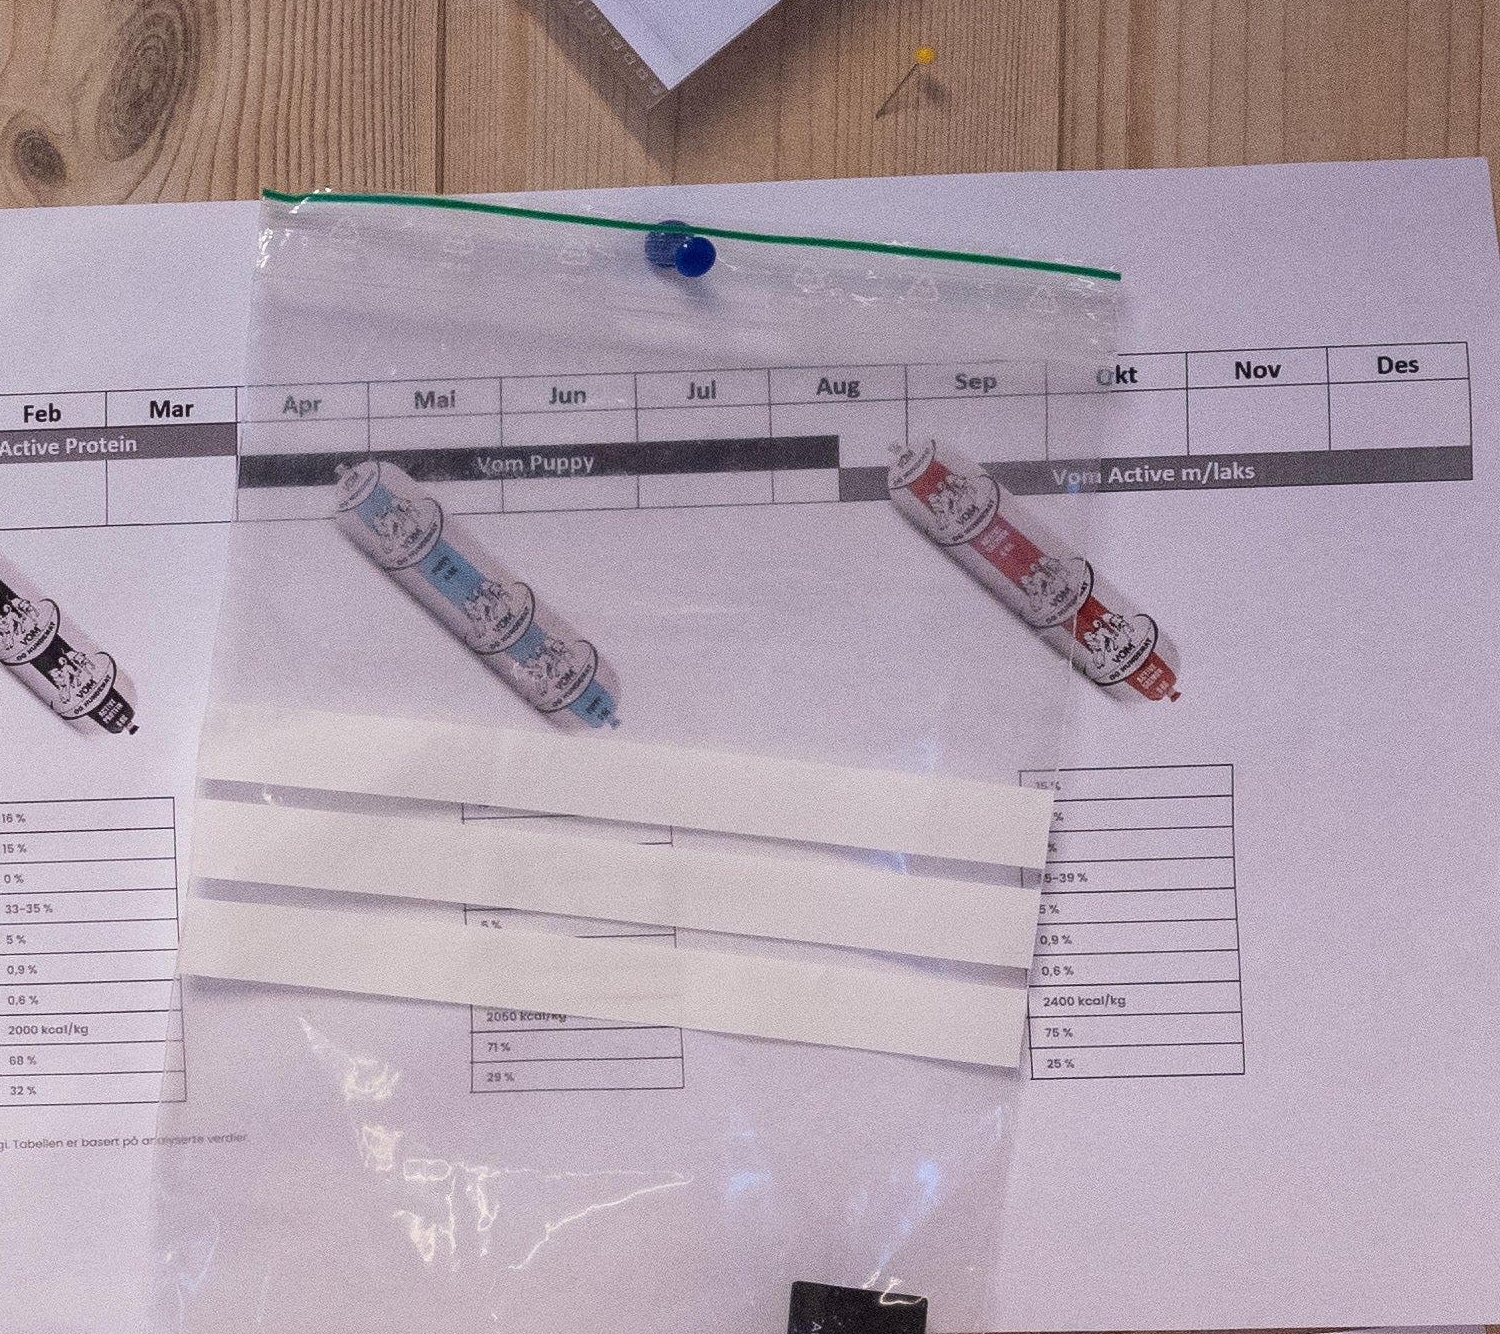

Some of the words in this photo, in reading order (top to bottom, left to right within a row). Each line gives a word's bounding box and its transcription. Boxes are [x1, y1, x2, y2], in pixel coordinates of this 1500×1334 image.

[1096, 364, 1138, 386] Okt
[1234, 360, 1282, 380] Nov
[1377, 355, 1420, 375] Des
[687, 379, 717, 400] Jul
[816, 377, 861, 399] Aug
[954, 373, 998, 394] Sep
[414, 389, 456, 410] Mai
[549, 386, 587, 405] Jun
[23, 402, 62, 424] Feb
[149, 399, 194, 419] Mar
[282, 395, 322, 418] Apr
[65, 433, 141, 457] Protein
[477, 457, 524, 476] Vom
[530, 455, 594, 475] Puppy
[1050, 466, 1103, 487] Vom
[1108, 464, 1175, 484] Active
[1181, 461, 1256, 485] m/laks
